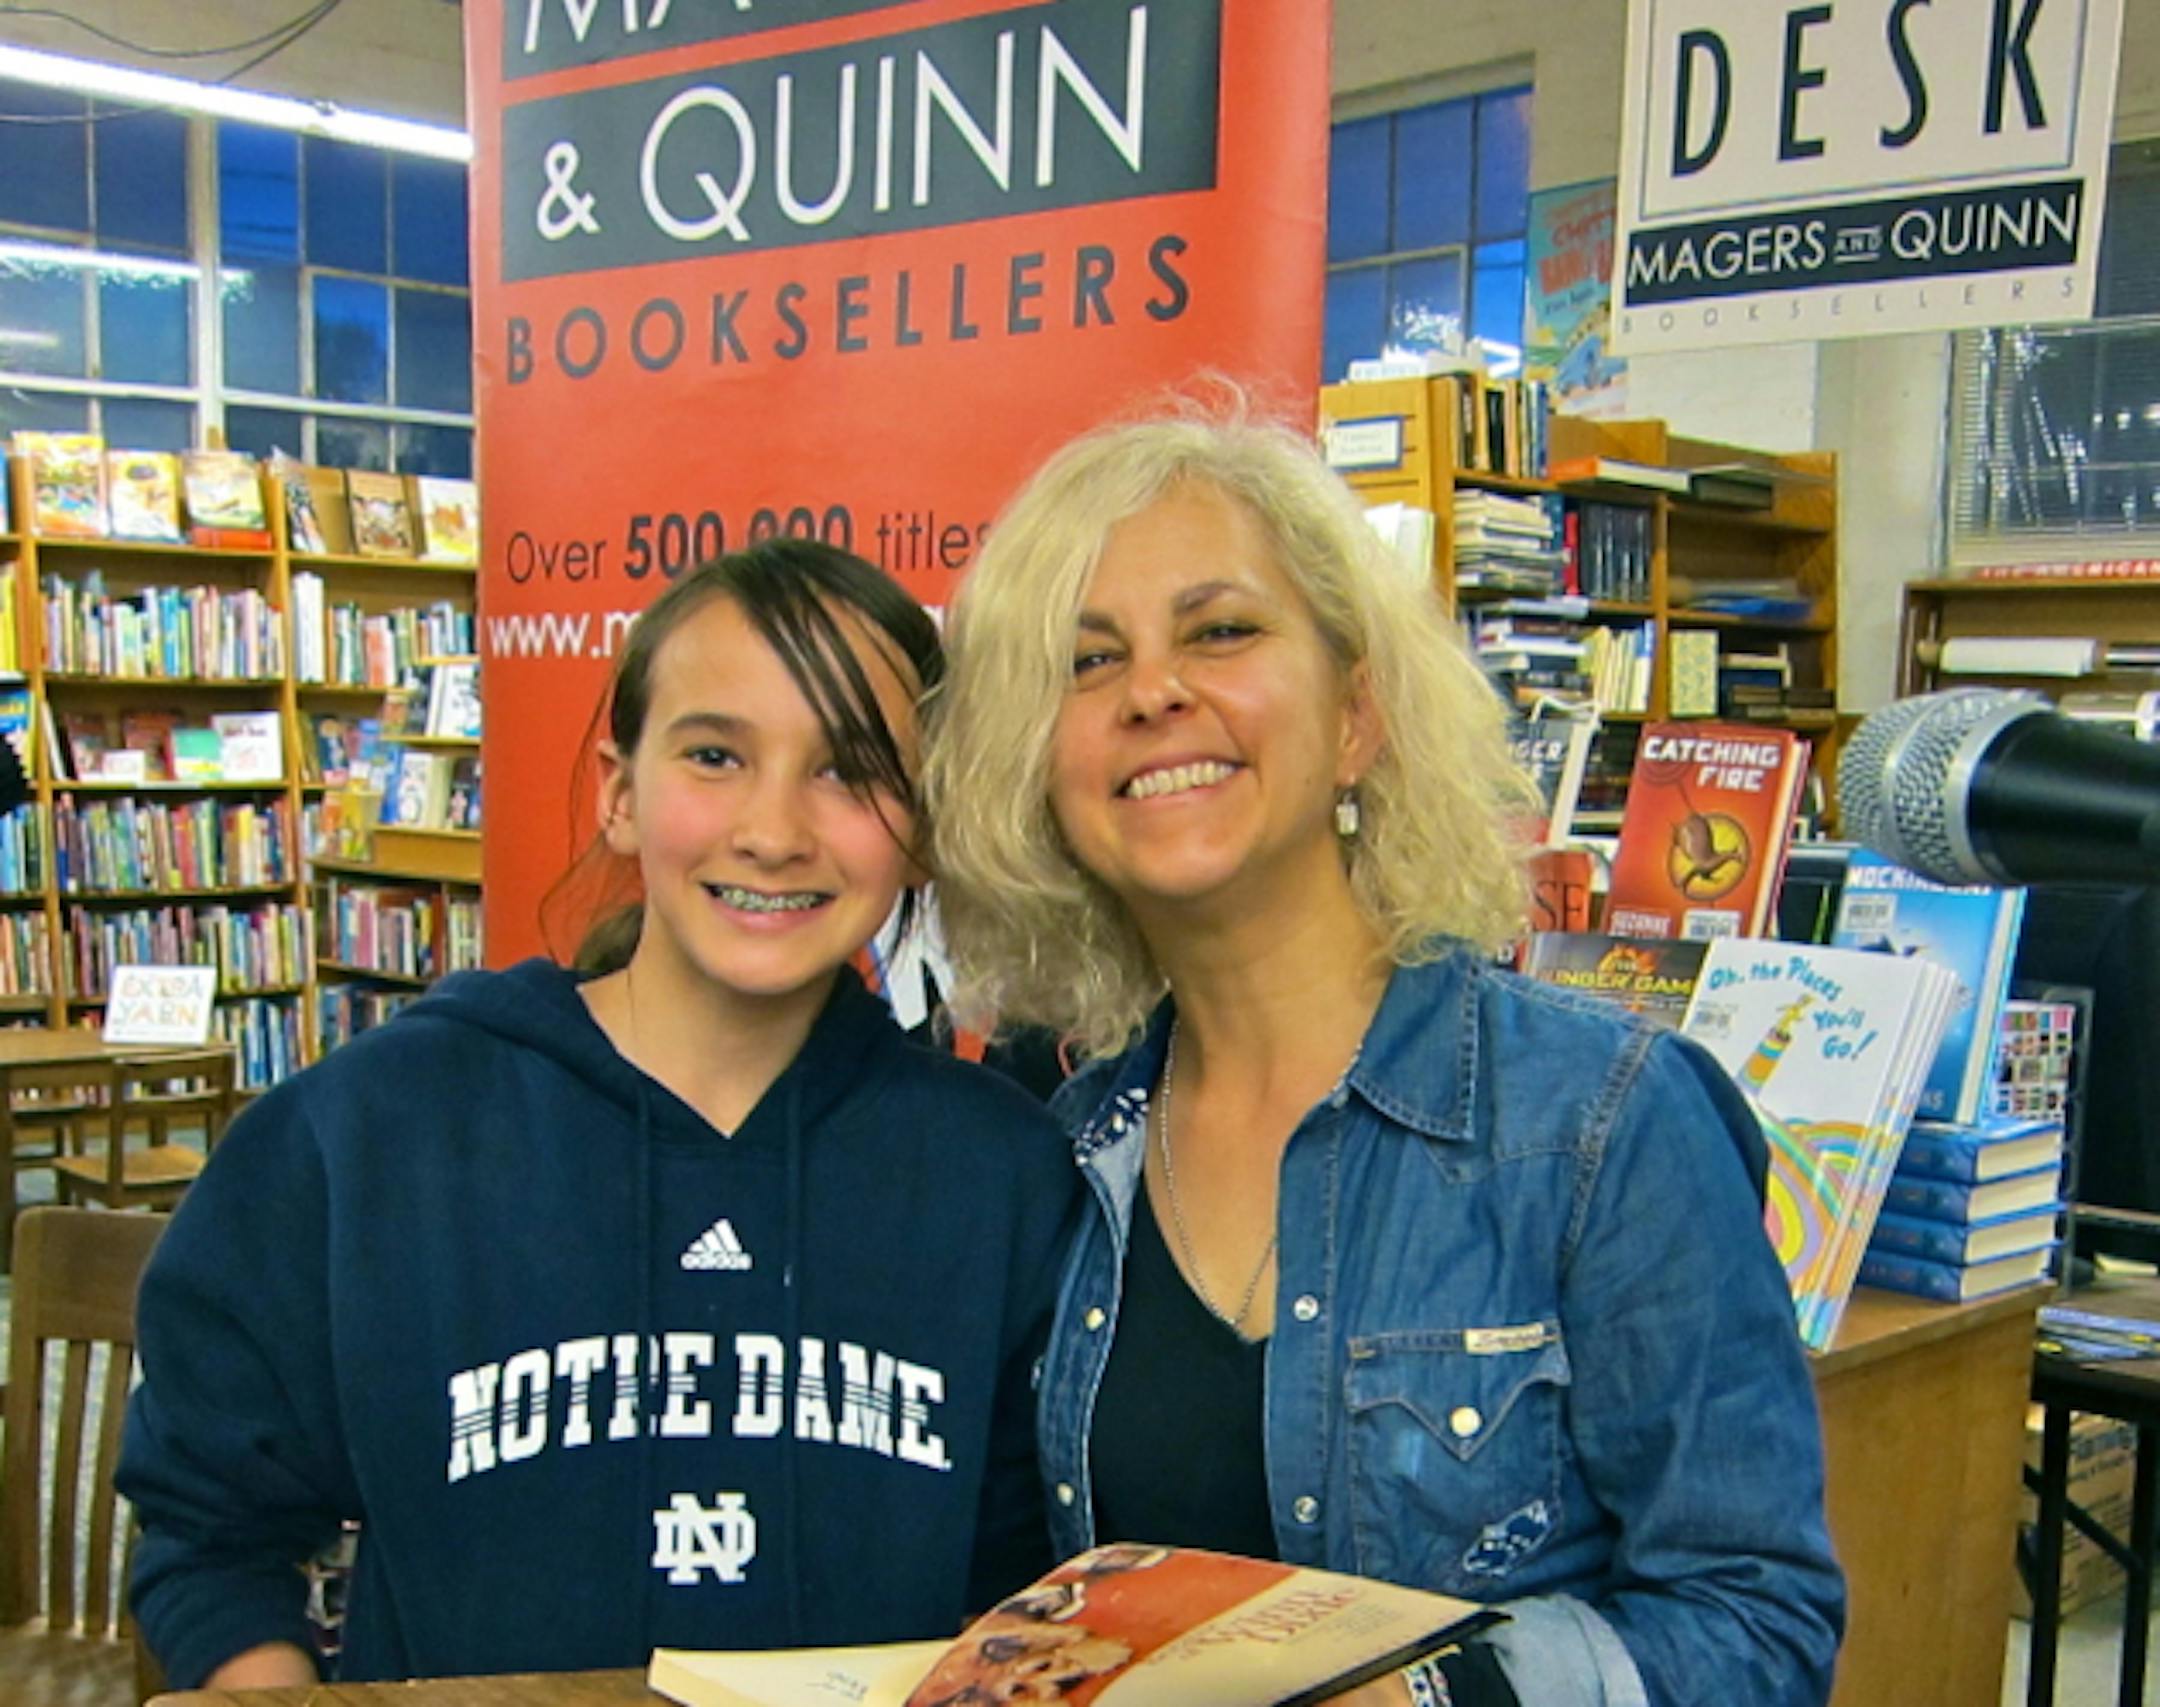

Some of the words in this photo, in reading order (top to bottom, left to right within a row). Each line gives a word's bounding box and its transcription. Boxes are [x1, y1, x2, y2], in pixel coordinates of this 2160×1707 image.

[1671, 0, 2048, 178] DESK
[536, 141, 600, 240] &
[639, 6, 1148, 243] QUINN
[1627, 220, 1826, 289] MAGERS
[1833, 231, 1882, 254] AND
[1890, 193, 2077, 261] QUINN
[507, 236, 1190, 386] BOOKSELLERS
[1622, 276, 2073, 333] BOOKSELLERS
[506, 531, 607, 584] Over
[624, 504, 853, 580] 500000
[1643, 732, 1781, 768] CATCHING
[1696, 765, 1765, 793] FIRE
[1750, 959, 1782, 980] the
[1786, 955, 1843, 1002] Places
[1812, 1006, 1866, 1031] You'll
[1821, 1029, 1879, 1061] Go!
[731, 1332, 950, 1471] DAME
